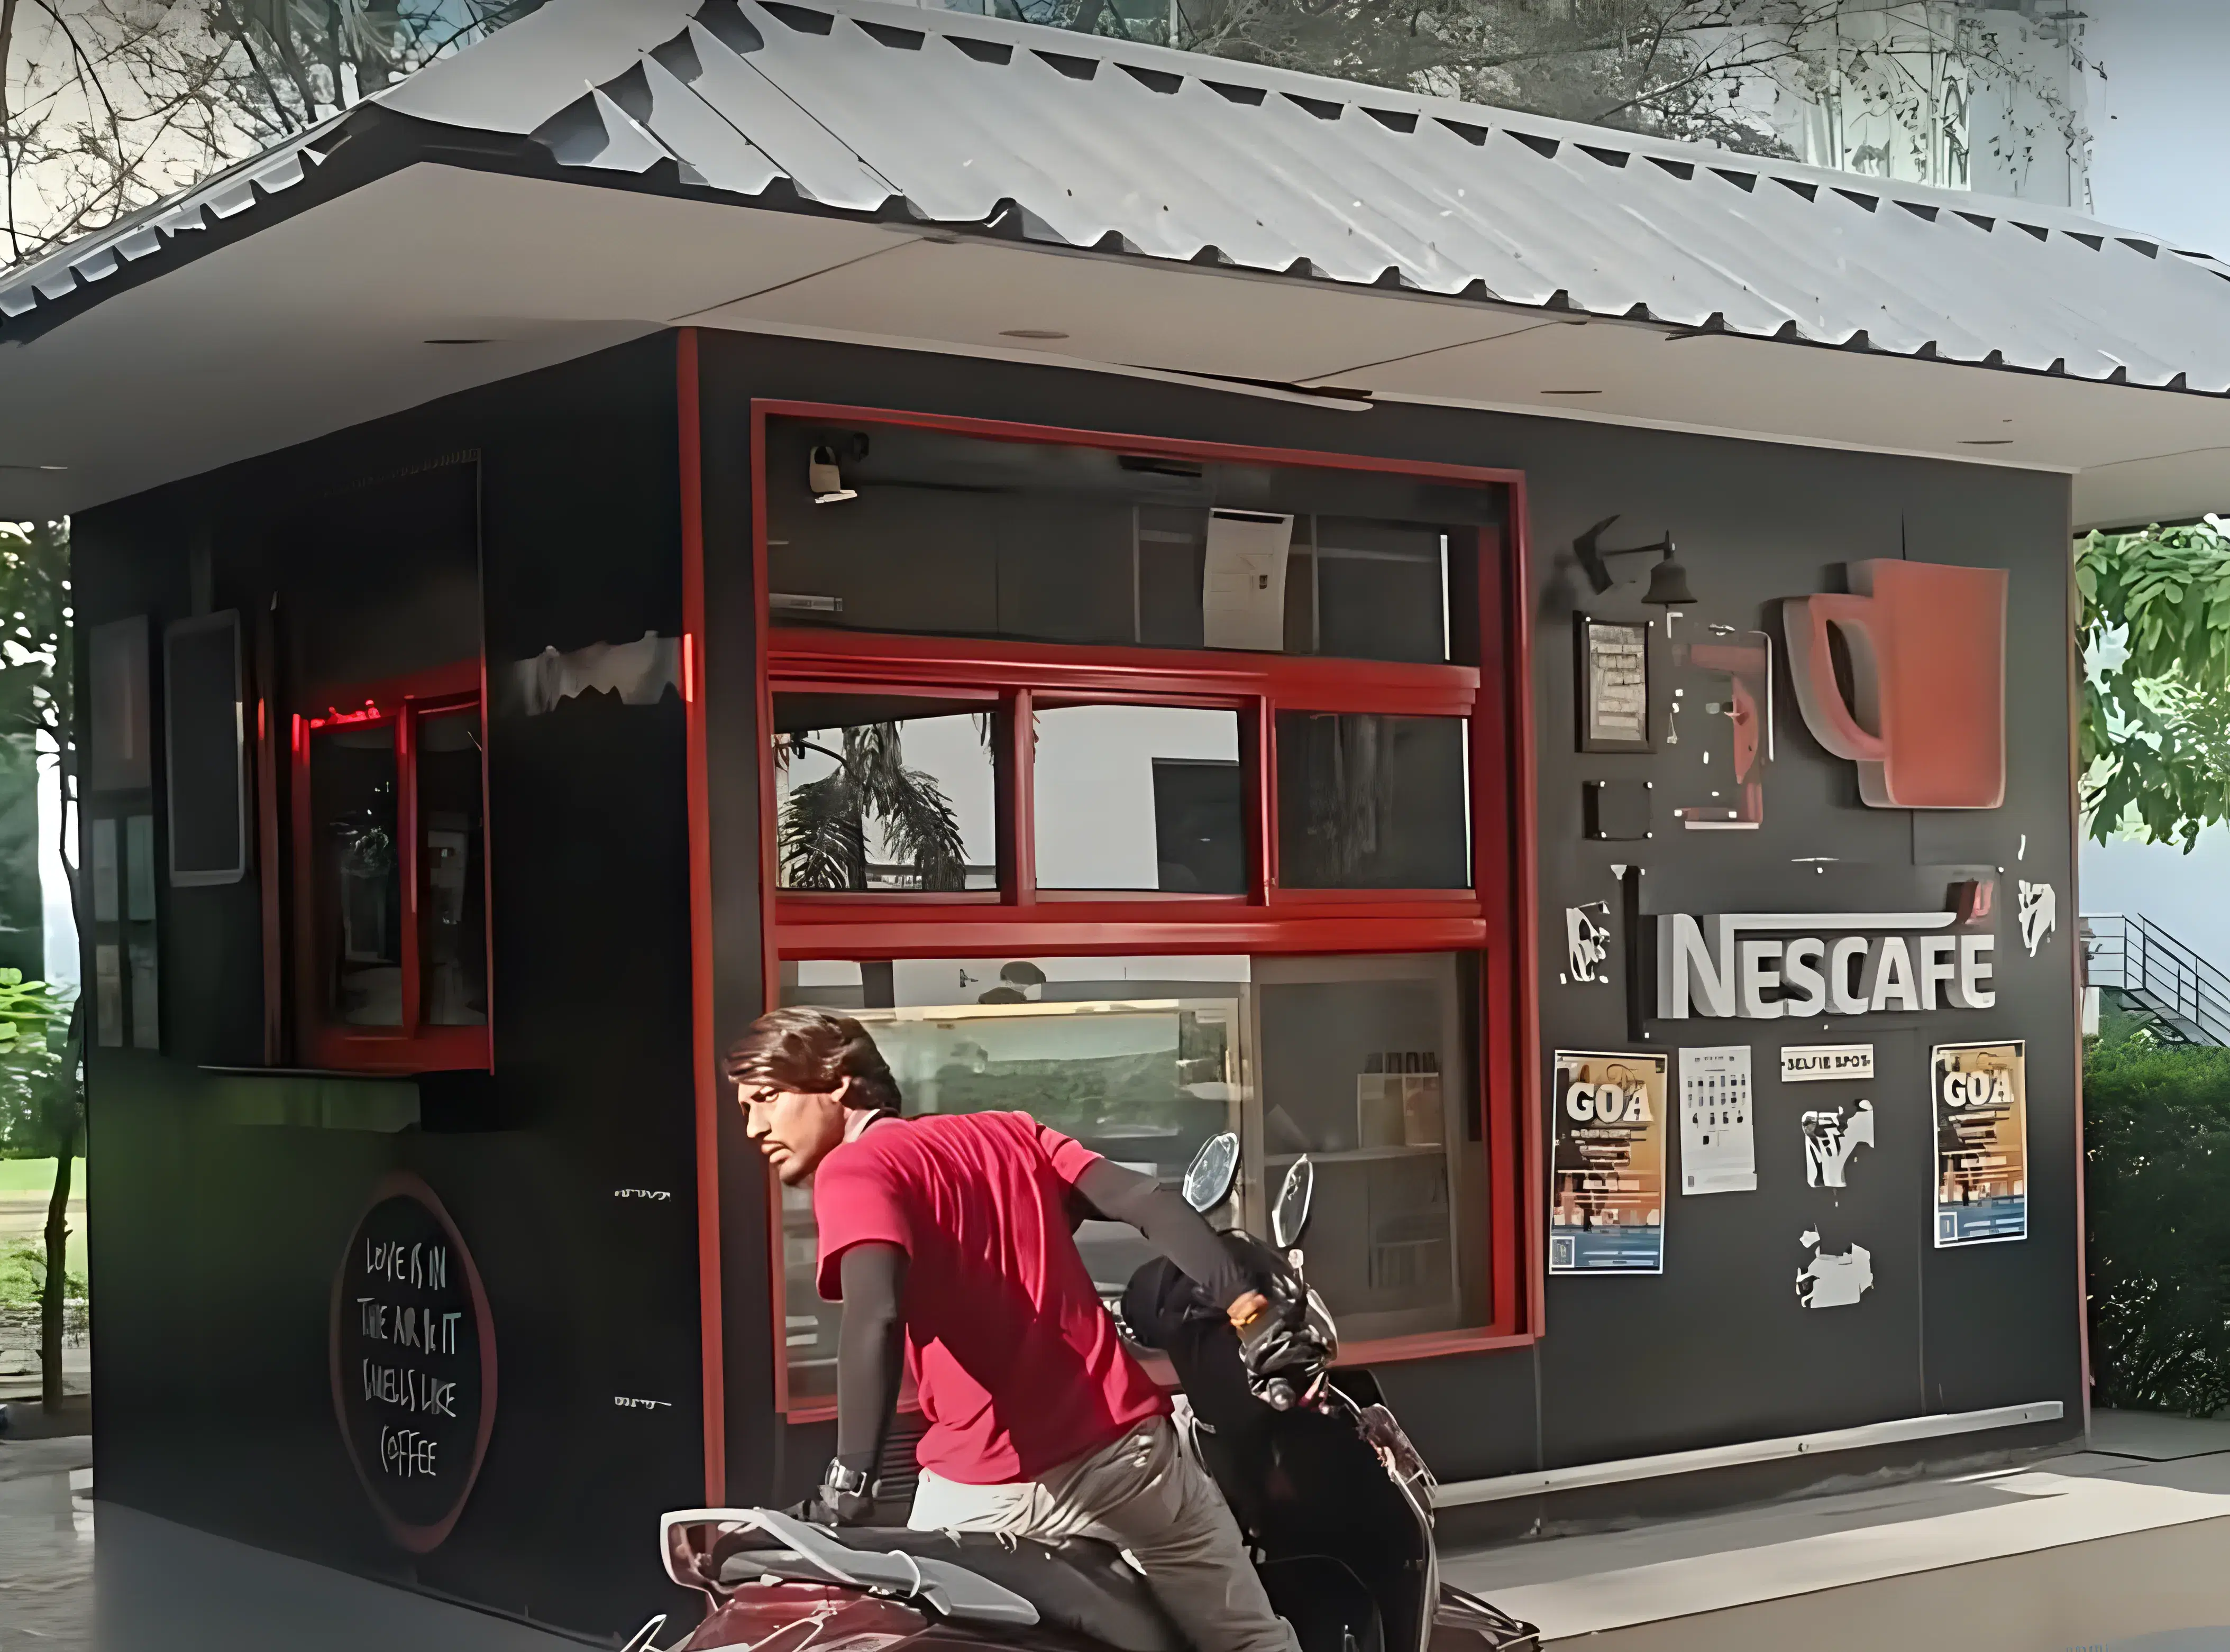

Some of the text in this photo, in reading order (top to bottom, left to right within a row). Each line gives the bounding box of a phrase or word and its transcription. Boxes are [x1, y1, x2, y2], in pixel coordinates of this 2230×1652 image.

[1566, 1082, 1653, 1124] GOA
[1943, 1069, 2014, 1107] GOA
[367, 1237, 406, 1282] LOVE
[381, 1424, 437, 1478] COFFEE
